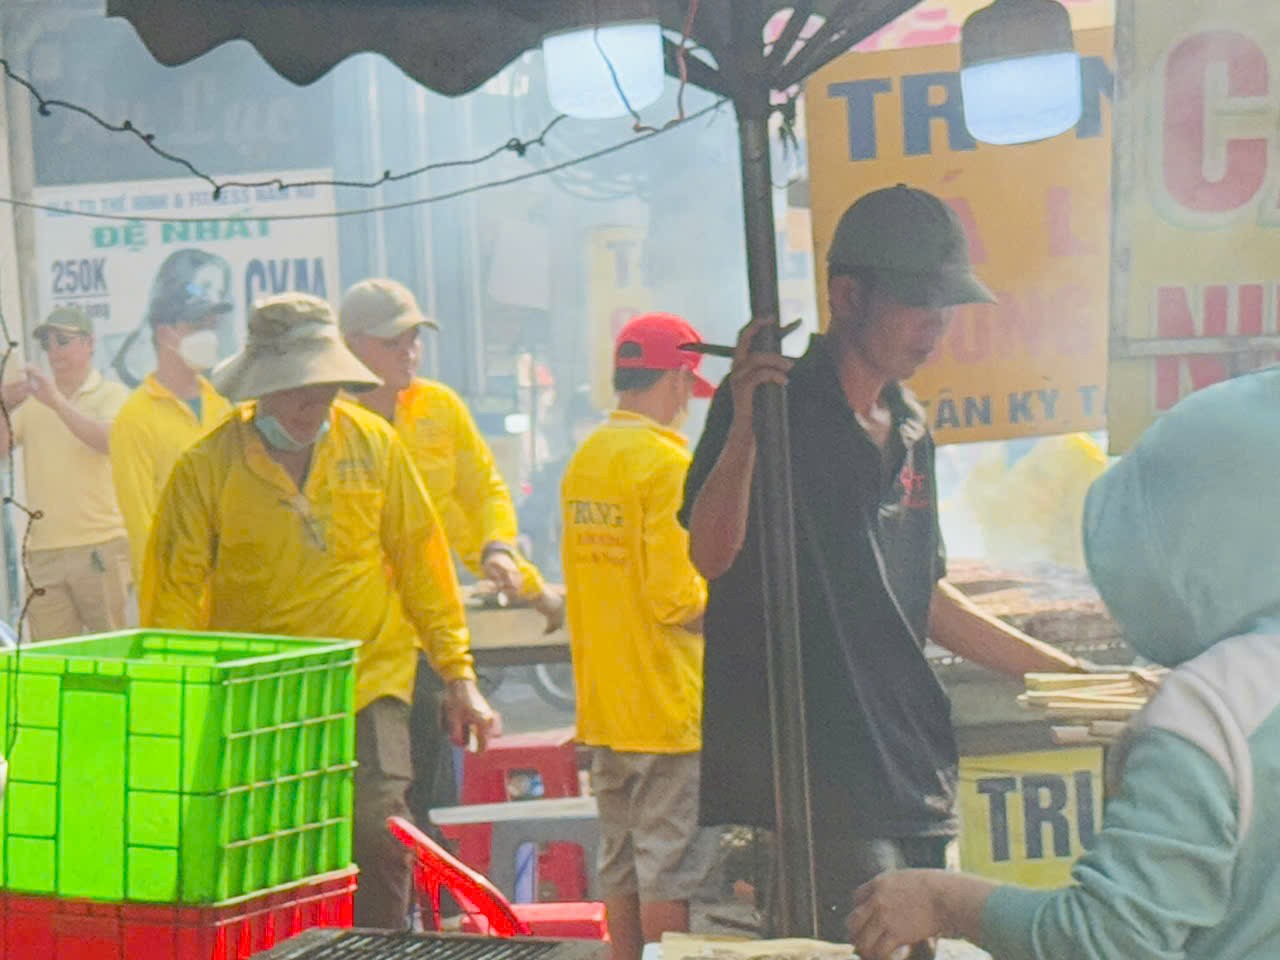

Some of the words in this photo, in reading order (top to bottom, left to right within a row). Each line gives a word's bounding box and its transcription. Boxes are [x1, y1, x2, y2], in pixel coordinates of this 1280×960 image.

[1163, 30, 1280, 214] C
[51, 257, 108, 294] 250K
[920, 387, 993, 430] ÂN
[1076, 385, 1107, 417] T
